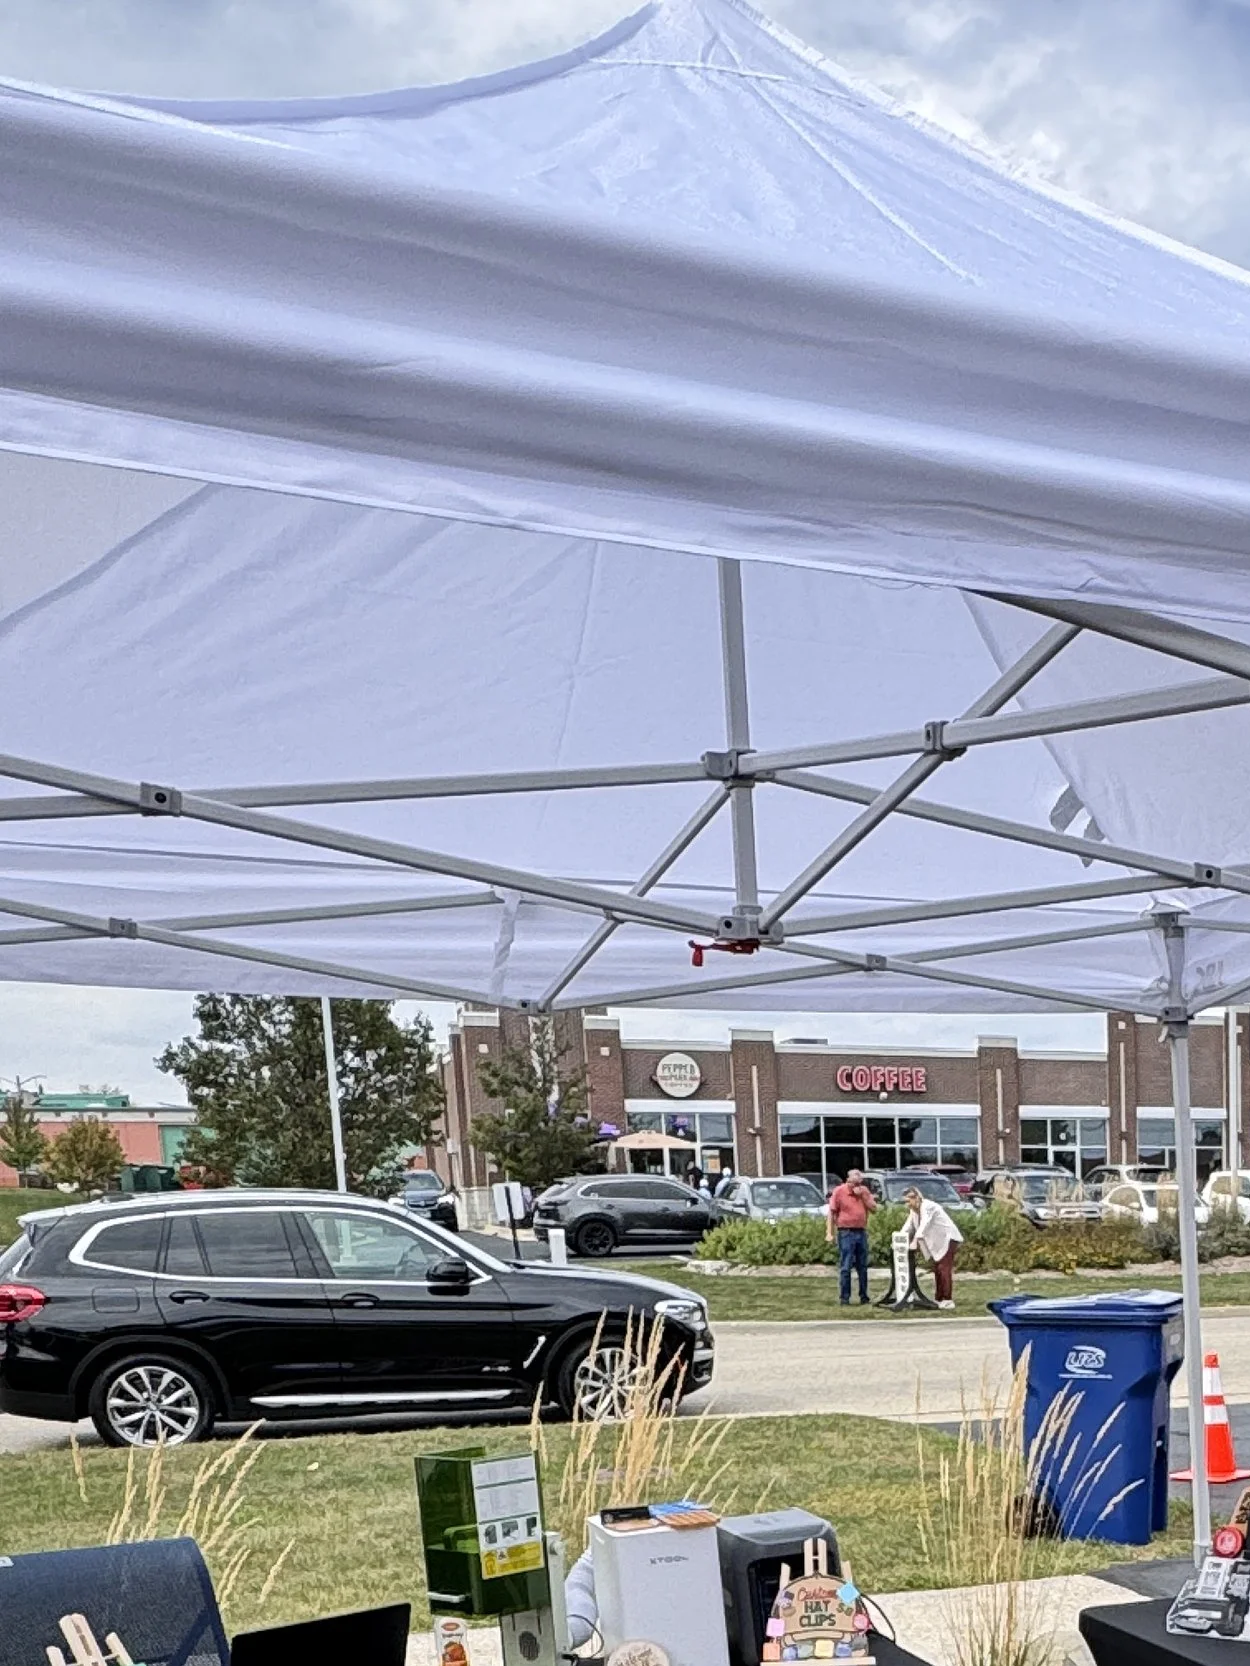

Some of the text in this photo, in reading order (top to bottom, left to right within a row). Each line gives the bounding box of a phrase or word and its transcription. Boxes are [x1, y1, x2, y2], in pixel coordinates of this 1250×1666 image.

[837, 1065, 927, 1092] COFFEE
[804, 1600, 831, 1613] HAT
[799, 1613, 836, 1627] CLIPS
